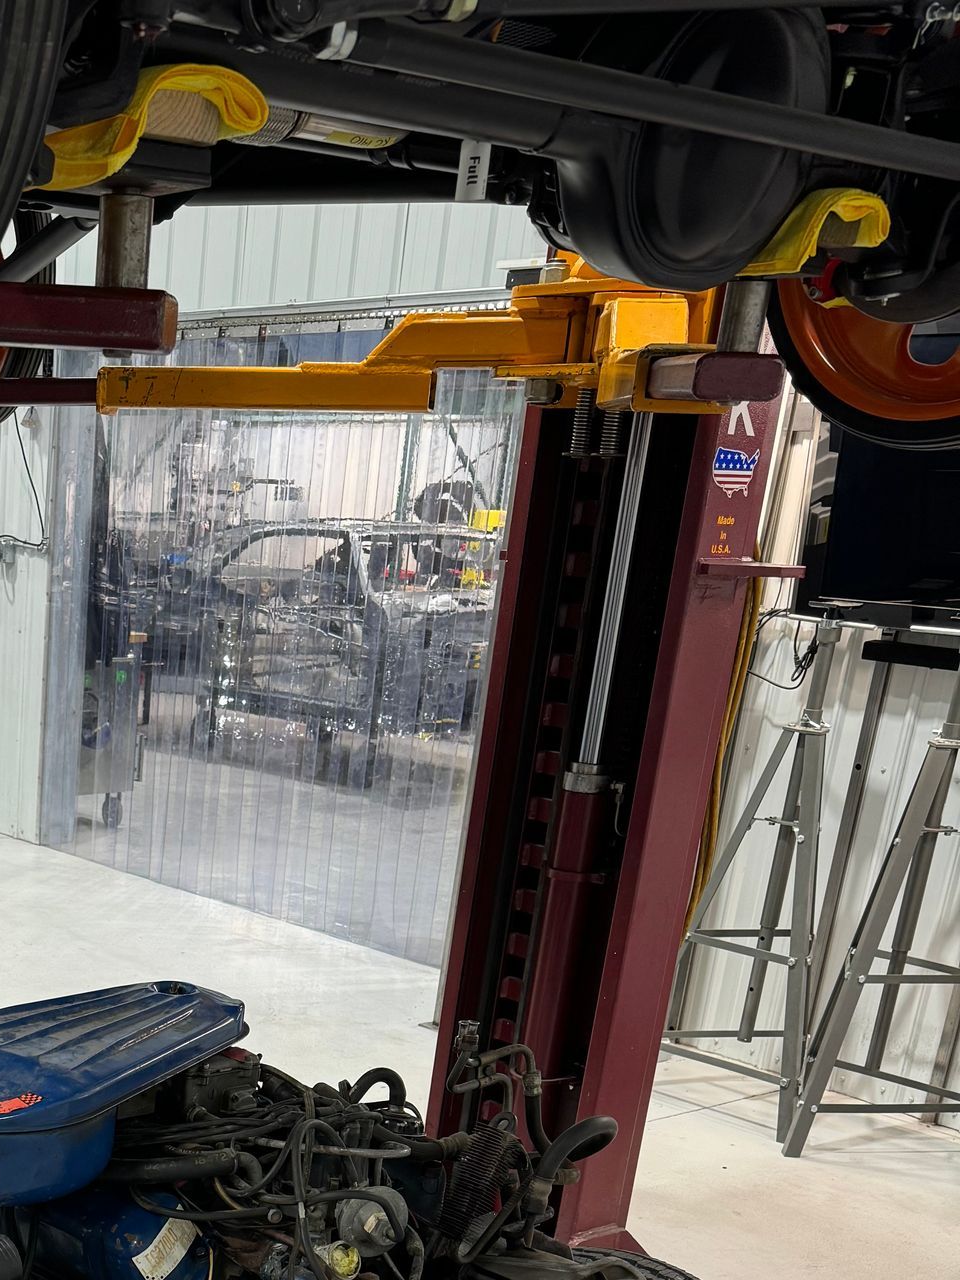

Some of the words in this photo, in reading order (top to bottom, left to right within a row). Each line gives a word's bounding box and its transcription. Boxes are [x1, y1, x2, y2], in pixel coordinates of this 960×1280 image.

[466, 156, 481, 186] Full
[716, 515, 735, 526] Made
[711, 544, 731, 555] U.S.A.
